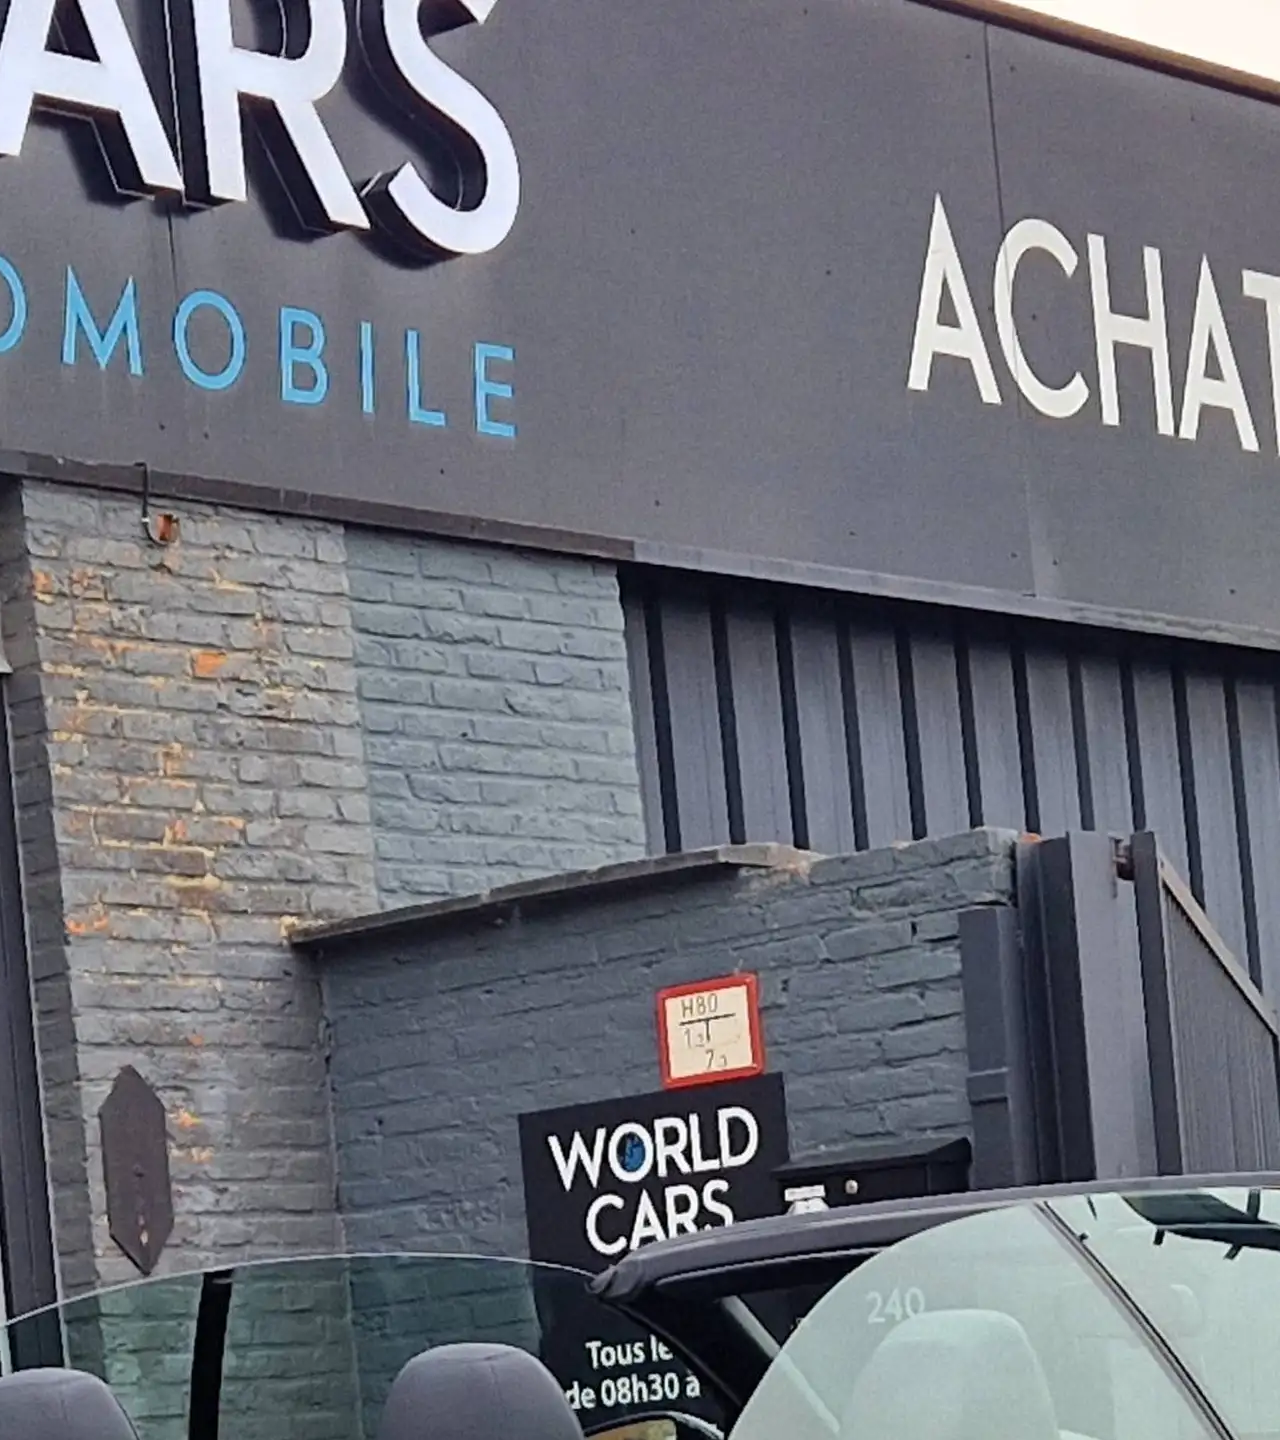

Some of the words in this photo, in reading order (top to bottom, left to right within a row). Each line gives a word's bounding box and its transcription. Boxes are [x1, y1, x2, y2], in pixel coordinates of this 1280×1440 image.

[681, 993, 718, 1018] H80
[548, 1106, 759, 1192] WORLD
[586, 1179, 734, 1255] CARS
[867, 1287, 925, 1324] 240
[585, 1340, 645, 1370] Tous
[565, 1381, 596, 1410] de
[601, 1372, 680, 1407] 08h30
